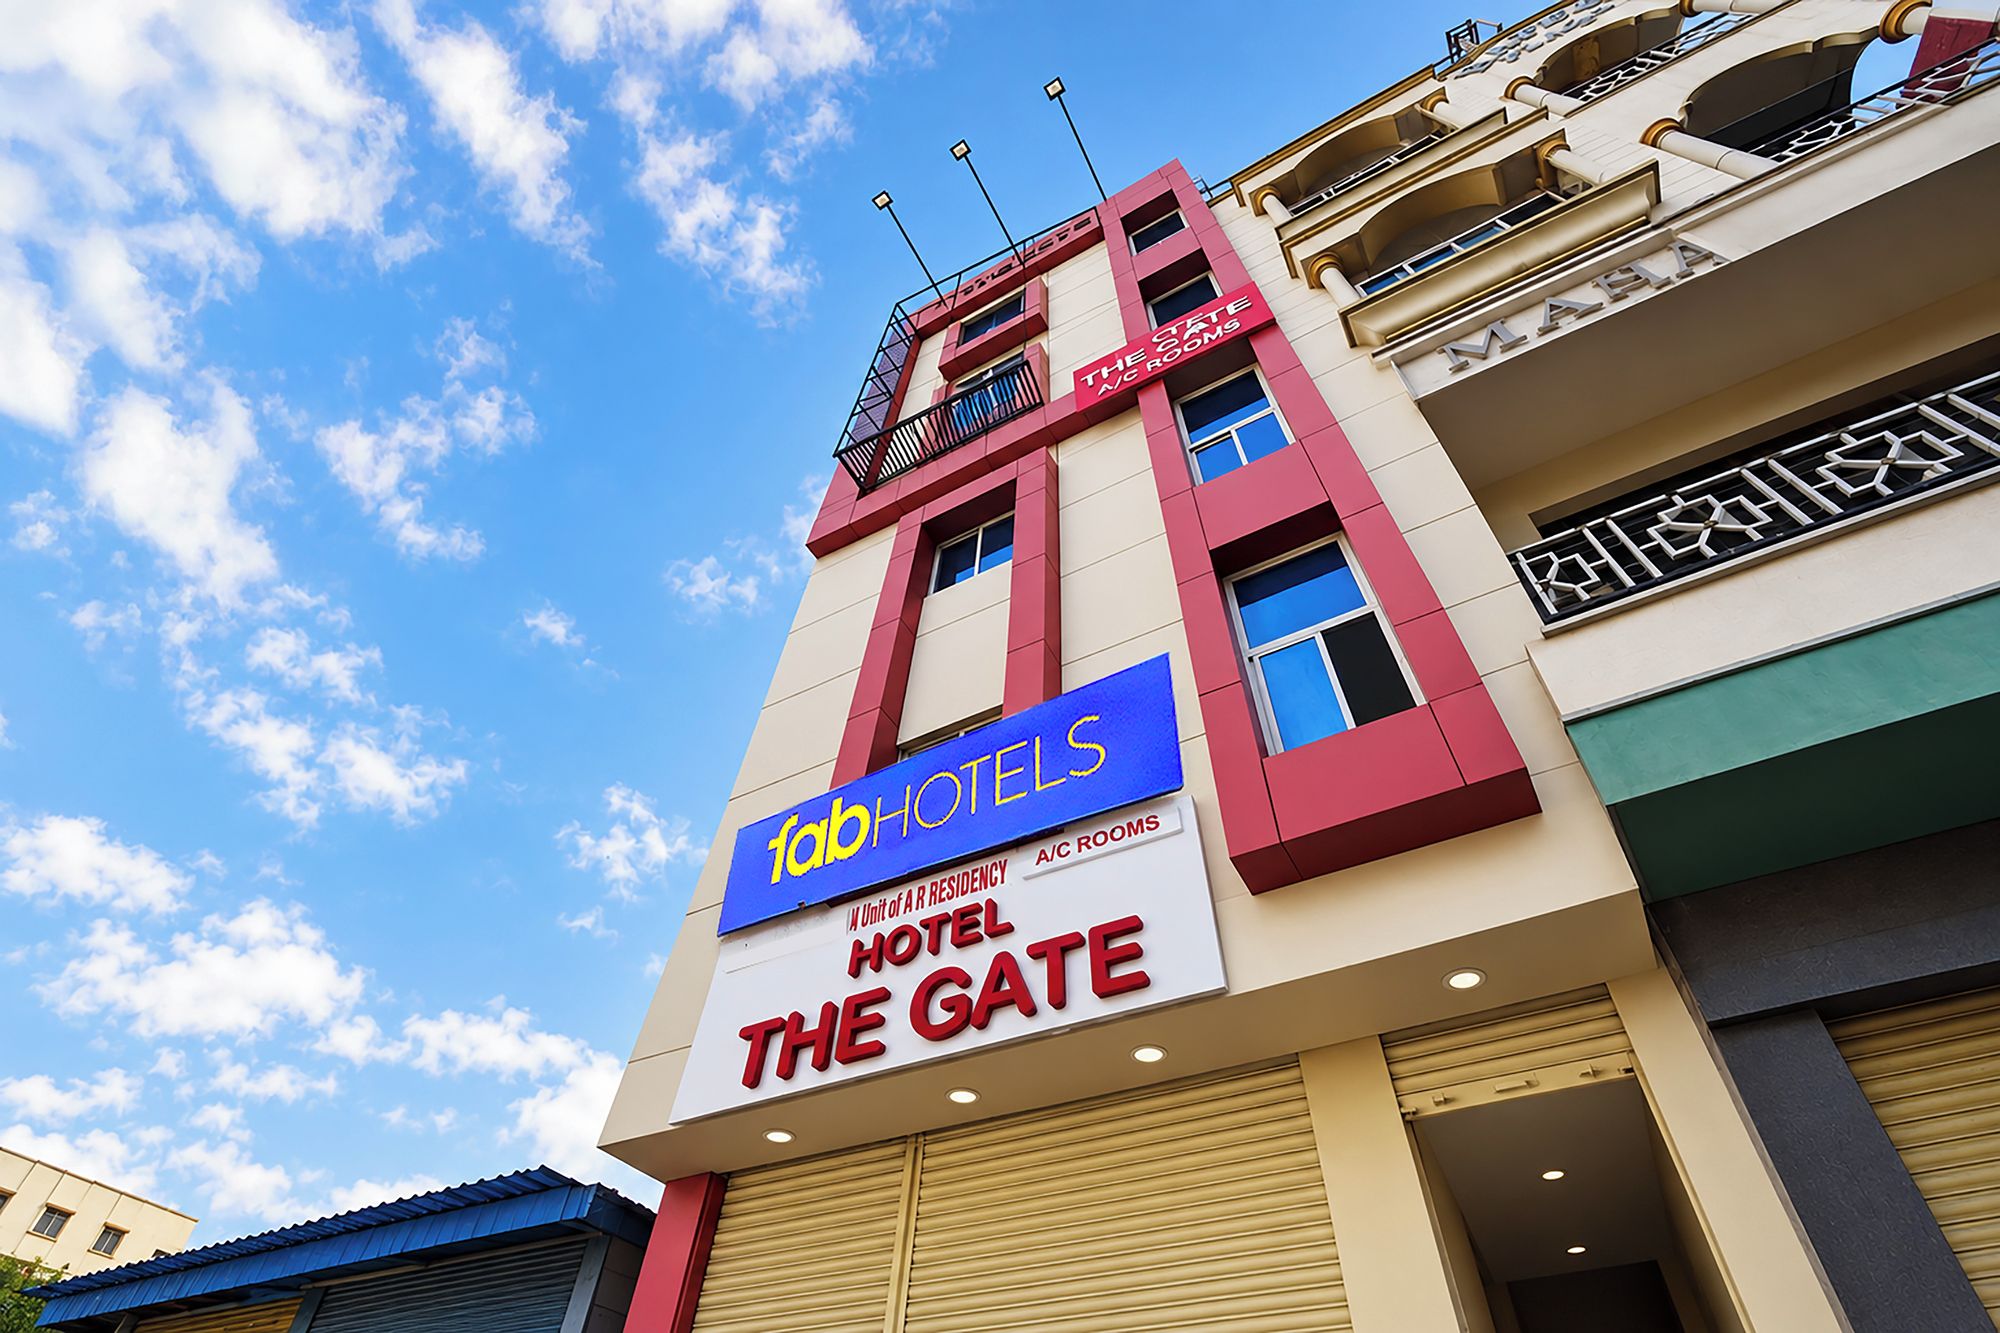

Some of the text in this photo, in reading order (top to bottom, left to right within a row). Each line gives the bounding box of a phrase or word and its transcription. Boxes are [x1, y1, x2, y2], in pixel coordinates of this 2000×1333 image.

[1080, 347, 1147, 388] THE
[1097, 318, 1241, 396] A/C ROOMS
[1035, 814, 1160, 866] A/C ROOMS
[861, 898, 887, 928] Unit
[888, 892, 903, 919] of
[903, 888, 912, 914] A
[915, 885, 926, 911] R
[928, 858, 1008, 907] RESIDENCY
[847, 897, 1015, 979] HOTEL
[738, 914, 1152, 1089] THE GATE
